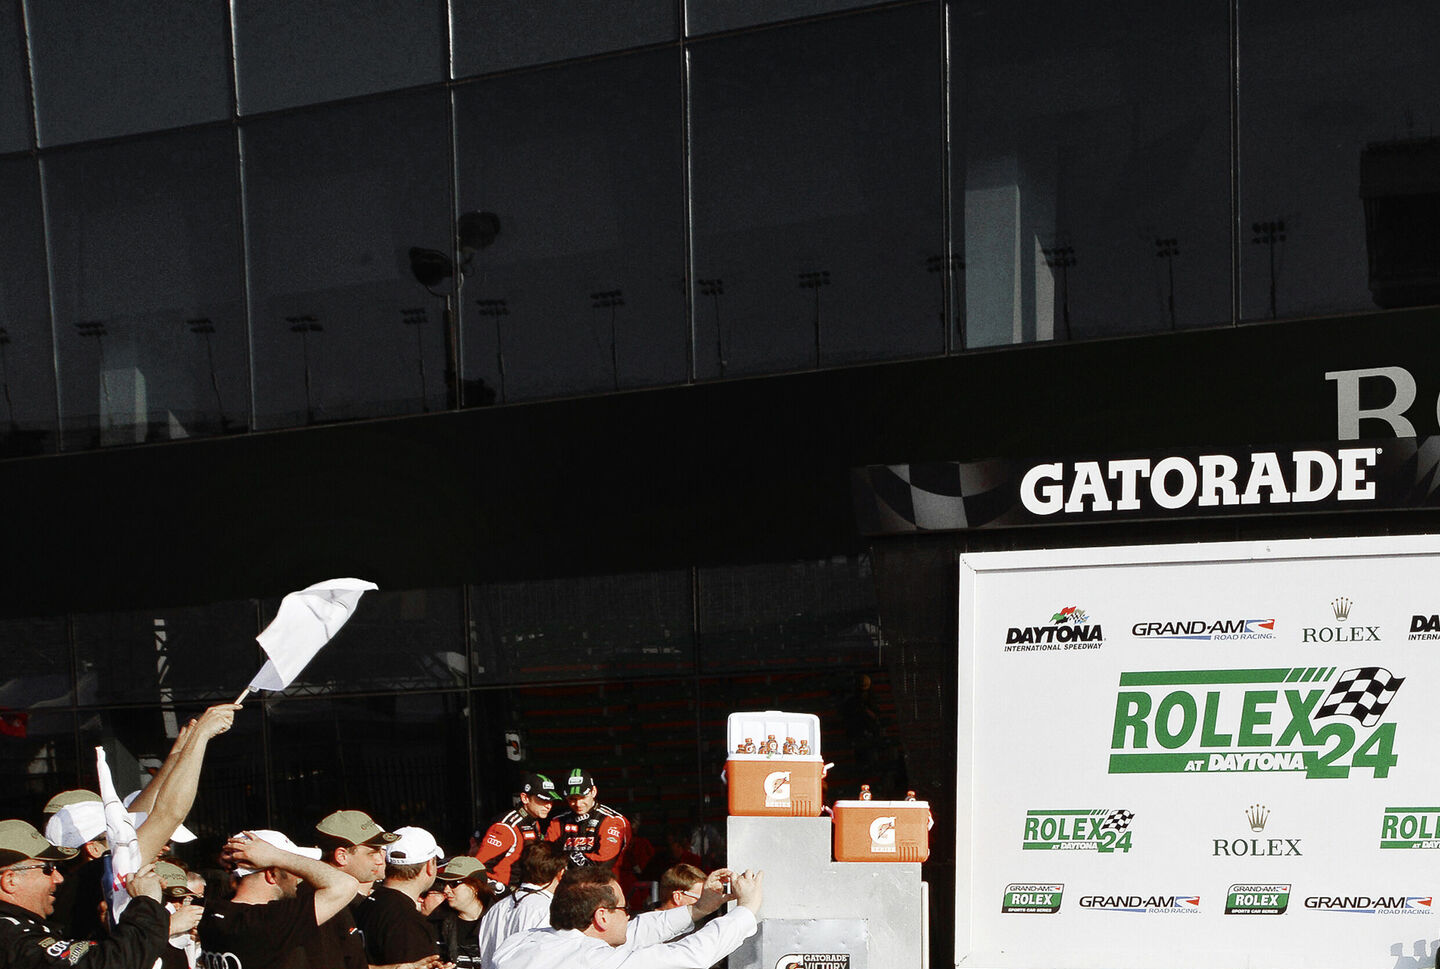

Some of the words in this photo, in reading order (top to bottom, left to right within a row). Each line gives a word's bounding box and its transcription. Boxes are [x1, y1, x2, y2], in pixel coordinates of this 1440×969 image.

[1020, 449, 1377, 515] GATORADE
[1005, 625, 1104, 644] DAYTONA
[1302, 626, 1381, 643] ROLEX
[1004, 644, 1061, 652] INTERNATIONAL
[1110, 689, 1326, 750] ROLEX
[1305, 722, 1398, 779] 24
[1184, 760, 1204, 771] AT
[1207, 752, 1306, 772] DAYTONA
[1023, 817, 1106, 840] ROLEX
[1098, 831, 1132, 853] 24
[1061, 842, 1098, 850] DAYTONA
[1212, 838, 1303, 857] ROLEX
[1012, 894, 1052, 905] ROLEX
[1235, 894, 1279, 906] ROLEX
